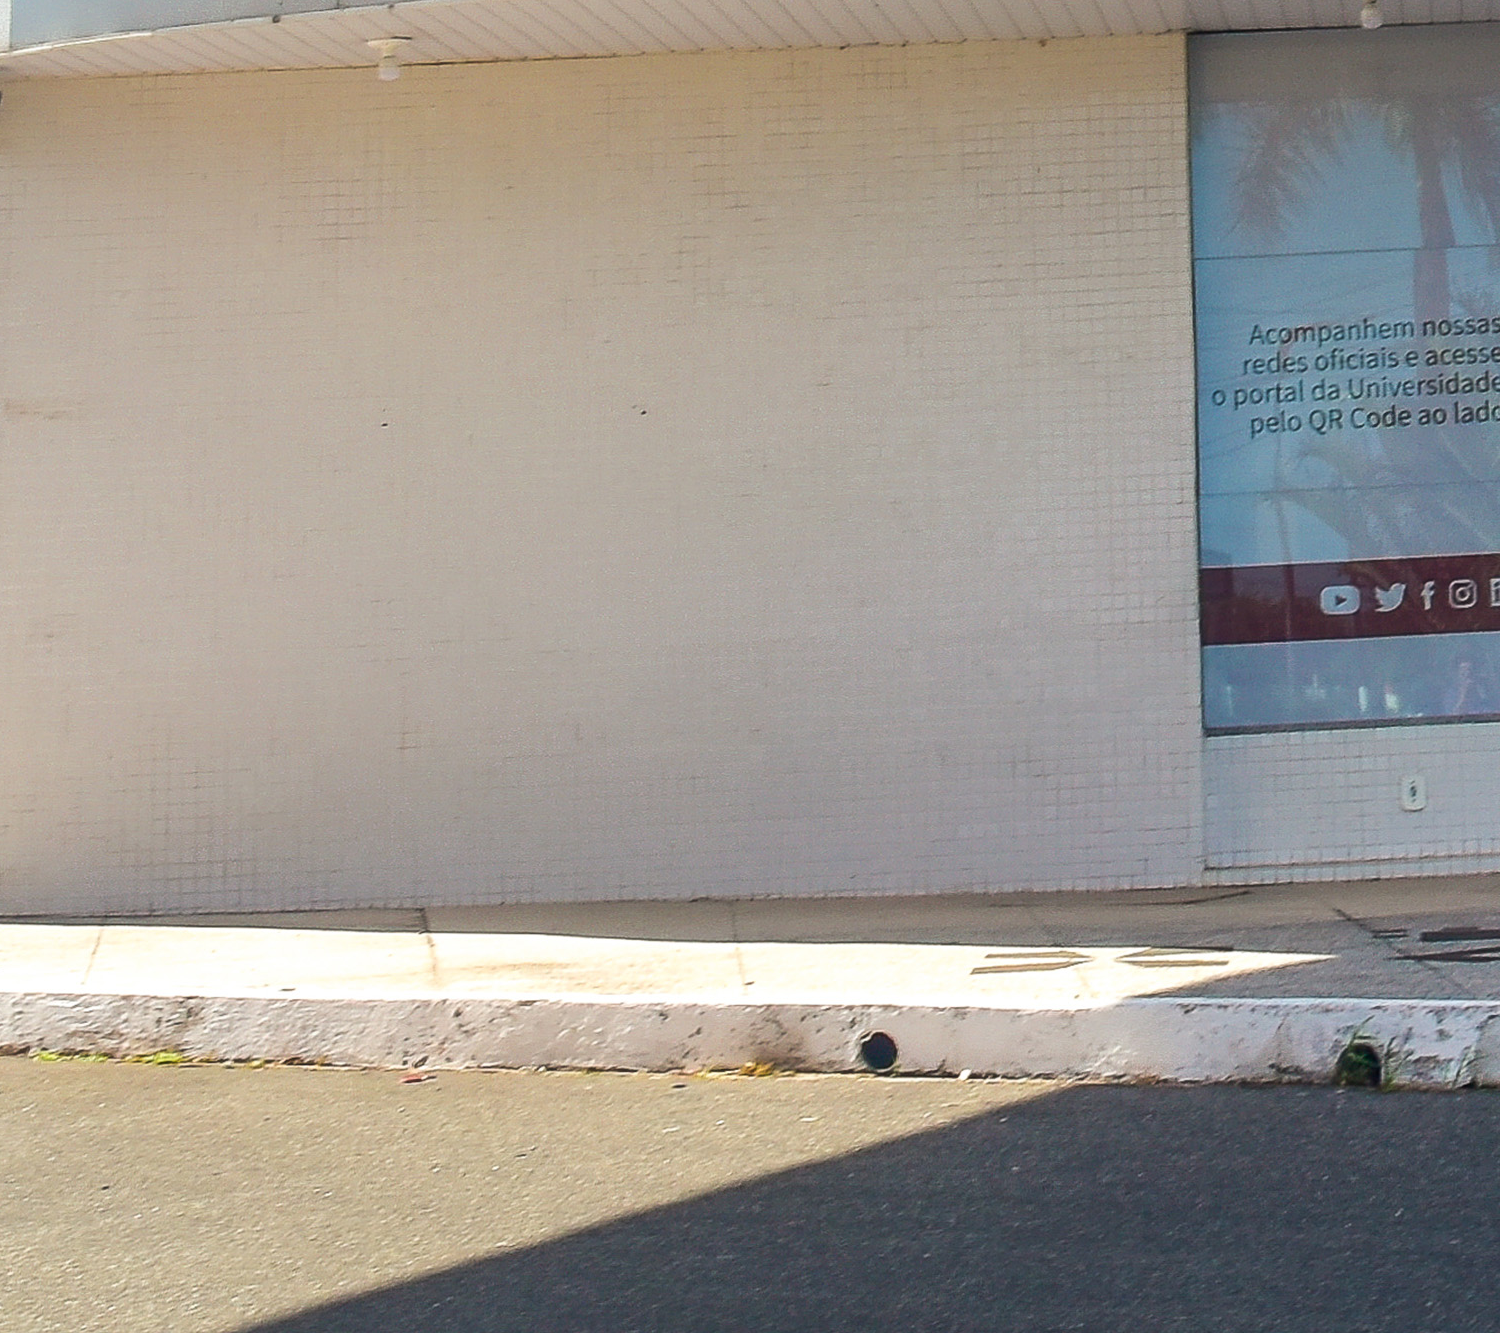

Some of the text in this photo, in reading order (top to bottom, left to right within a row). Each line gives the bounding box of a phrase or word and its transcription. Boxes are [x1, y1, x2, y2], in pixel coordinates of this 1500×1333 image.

[1249, 318, 1415, 347] Acompanhem
[1242, 352, 1308, 375] redes
[1314, 348, 1400, 372] oficiais
[1405, 350, 1419, 367] e
[1211, 388, 1226, 406] o
[1233, 379, 1304, 410] portal
[1311, 381, 1340, 401] da
[1250, 410, 1302, 439] pelo
[1308, 408, 1344, 434] QR
[1350, 405, 1412, 430] Code
[1417, 406, 1448, 426] ao
